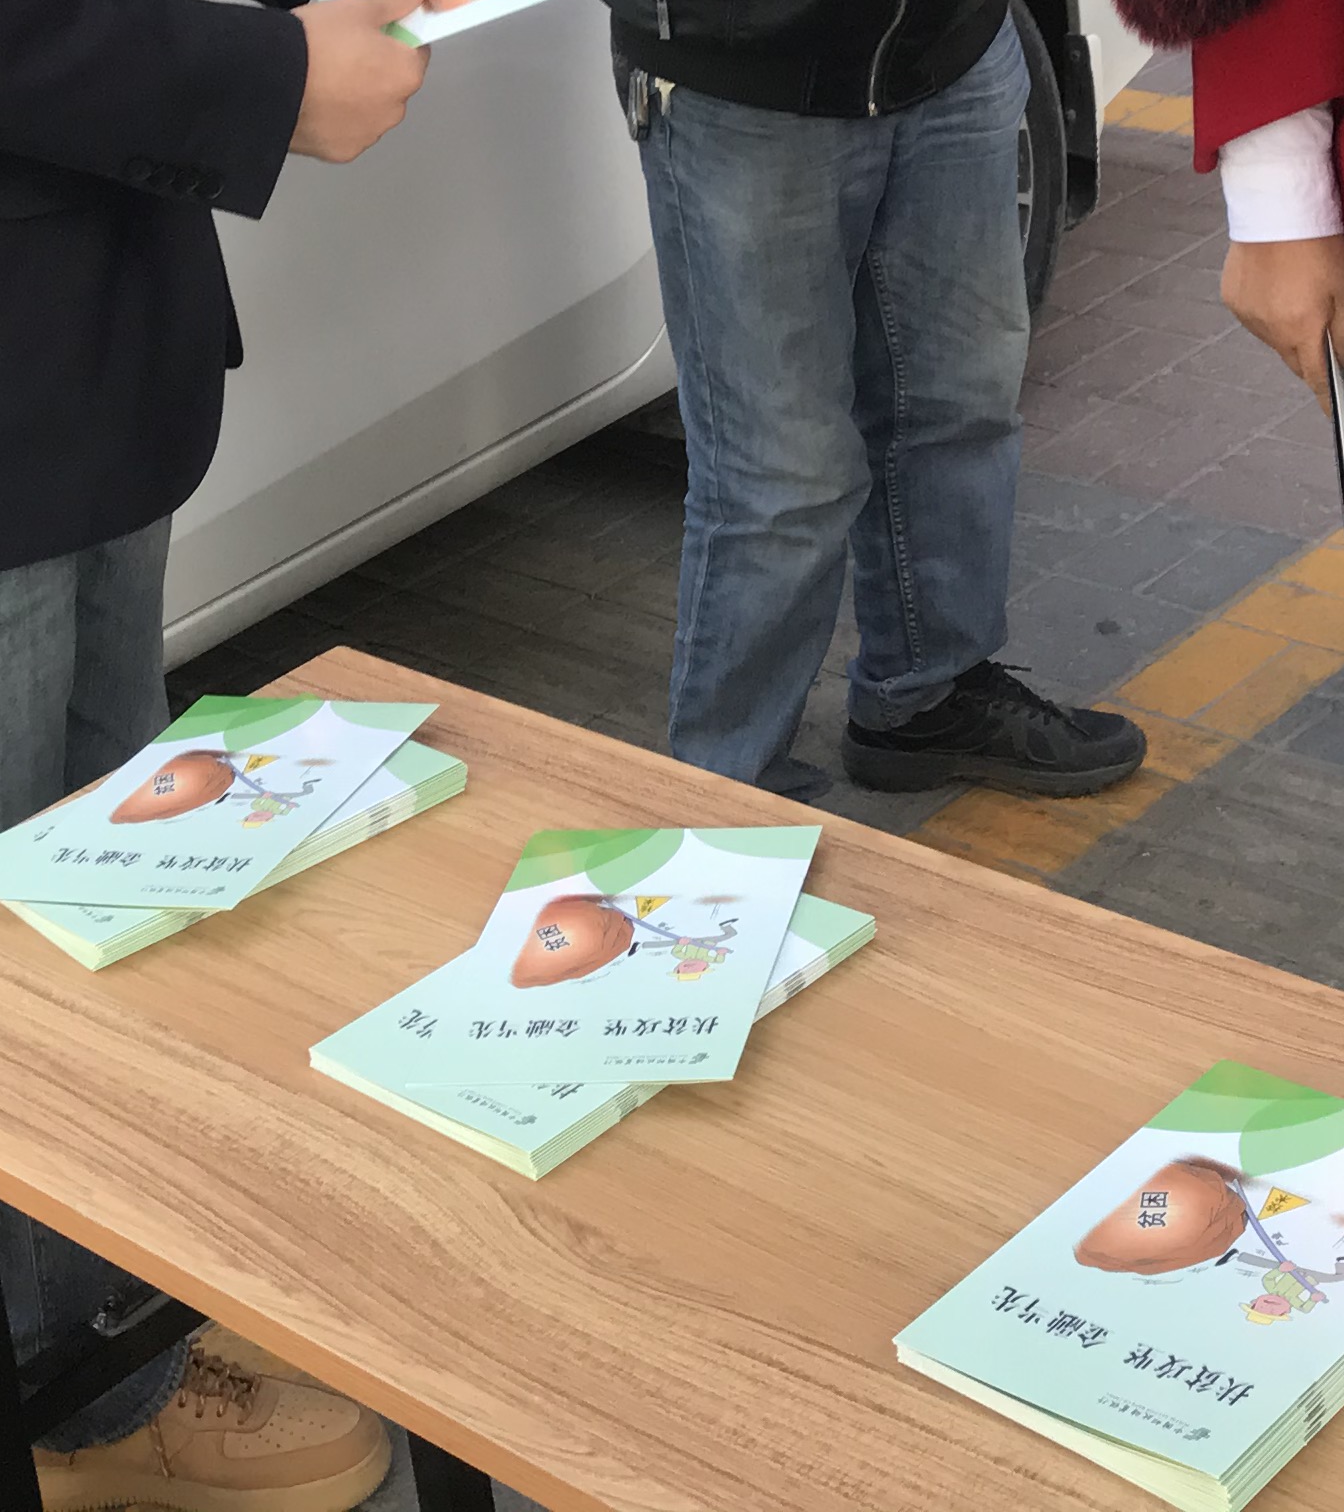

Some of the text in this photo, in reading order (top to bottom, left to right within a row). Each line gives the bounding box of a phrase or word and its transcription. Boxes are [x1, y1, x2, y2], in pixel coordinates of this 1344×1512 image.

[51, 845, 255, 874] 扶贫攻坚 金融当先
[535, 923, 570, 954] 贫困
[467, 1014, 720, 1041] 扶贫攻坚 金融当先
[1138, 1190, 1171, 1230] 贫困
[990, 1284, 1254, 1406] 扶贫攻坚 金融当先
[1097, 1395, 1192, 1439] 中国邮政储蓄银行
